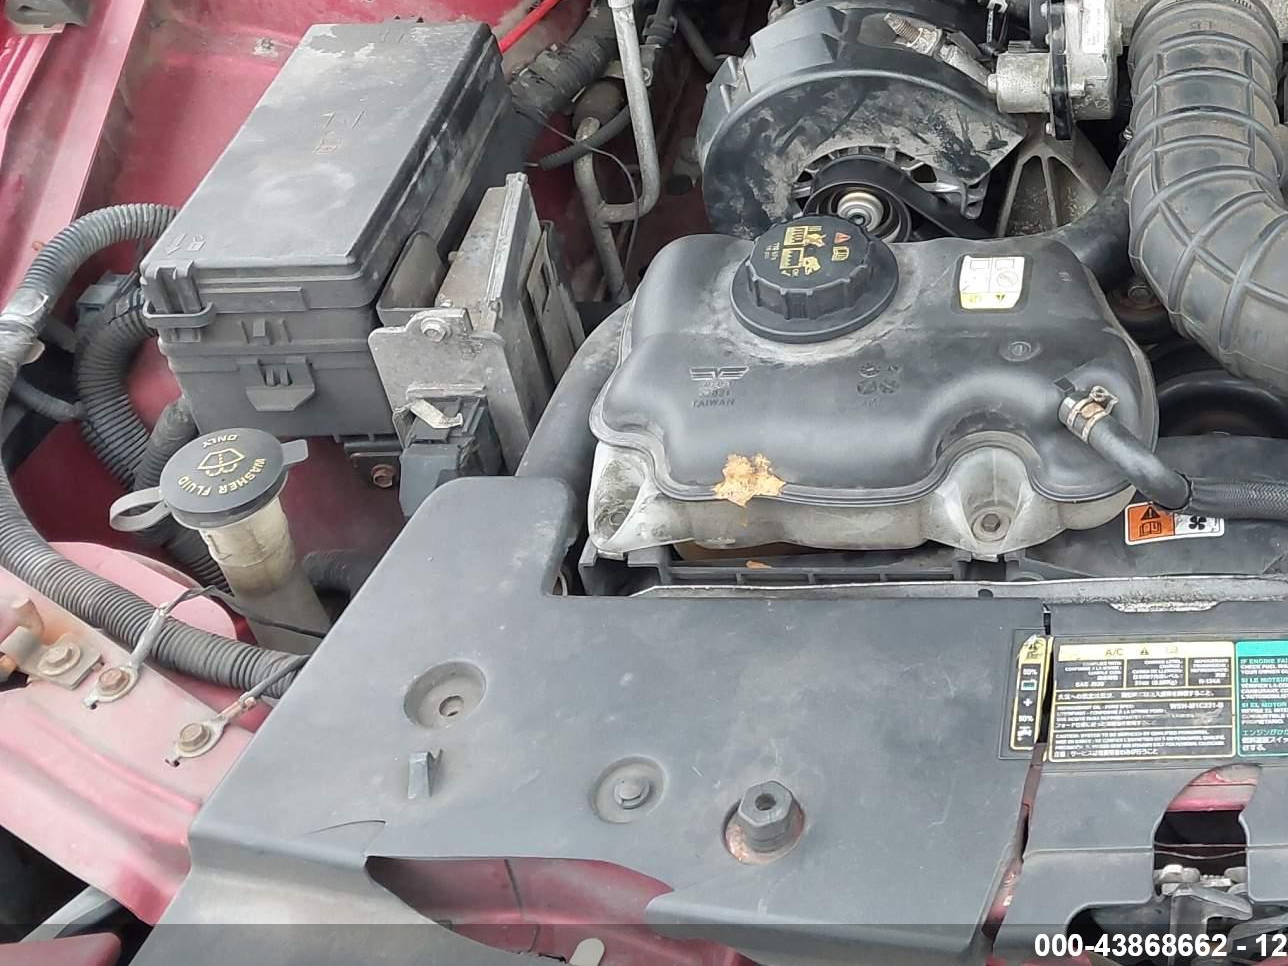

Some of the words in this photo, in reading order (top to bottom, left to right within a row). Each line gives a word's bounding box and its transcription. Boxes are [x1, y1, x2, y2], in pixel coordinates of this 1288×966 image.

[202, 434, 239, 449] ONLY
[177, 474, 212, 497] FLUID
[218, 458, 267, 496] WASHER
[1105, 648, 1124, 656] A/C
